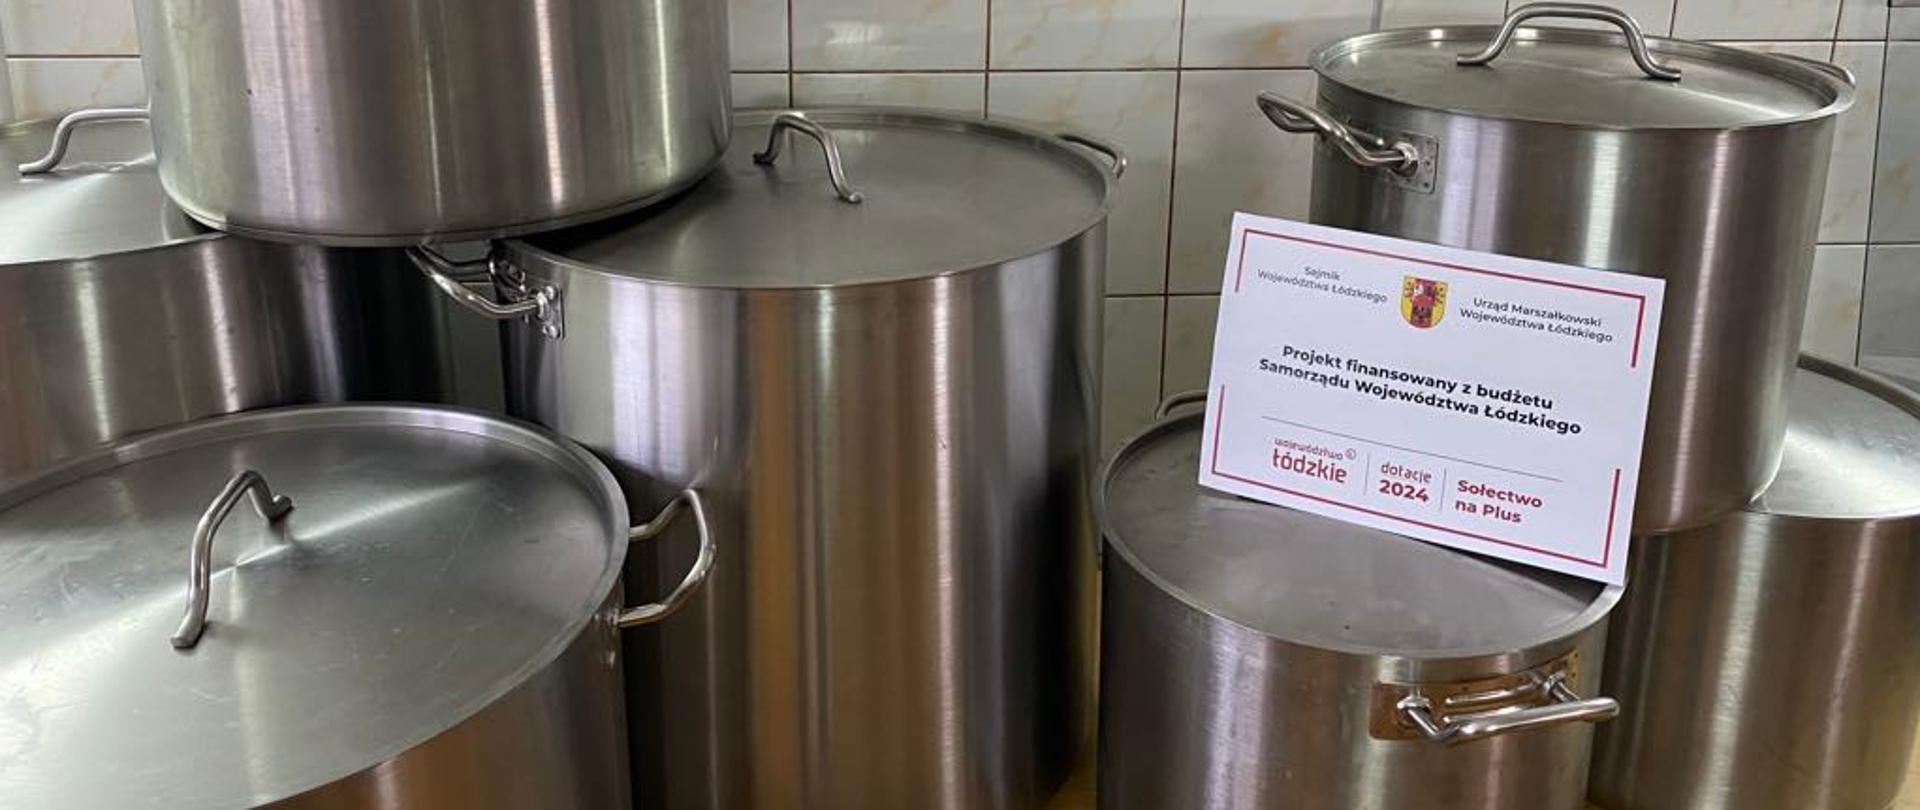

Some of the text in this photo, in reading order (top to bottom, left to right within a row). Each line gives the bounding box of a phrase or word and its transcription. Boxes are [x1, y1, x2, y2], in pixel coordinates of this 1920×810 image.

[1257, 270, 1388, 303] Województwa Łódzkiego
[1460, 308, 1613, 343] Województwa Łódzkiego
[1472, 297, 1602, 327] Urząd Marszałkowski
[1282, 345, 1553, 410] Projekt finansowany z budżetu
[1259, 358, 1581, 435] Samorządu Województwa Łódzkiego
[1272, 448, 1347, 483] łódzkie
[1380, 461, 1432, 484] dotacje
[1379, 480, 1430, 503] 2024
[1457, 479, 1542, 509] Sołectwo
[1455, 499, 1522, 524] na Plus
